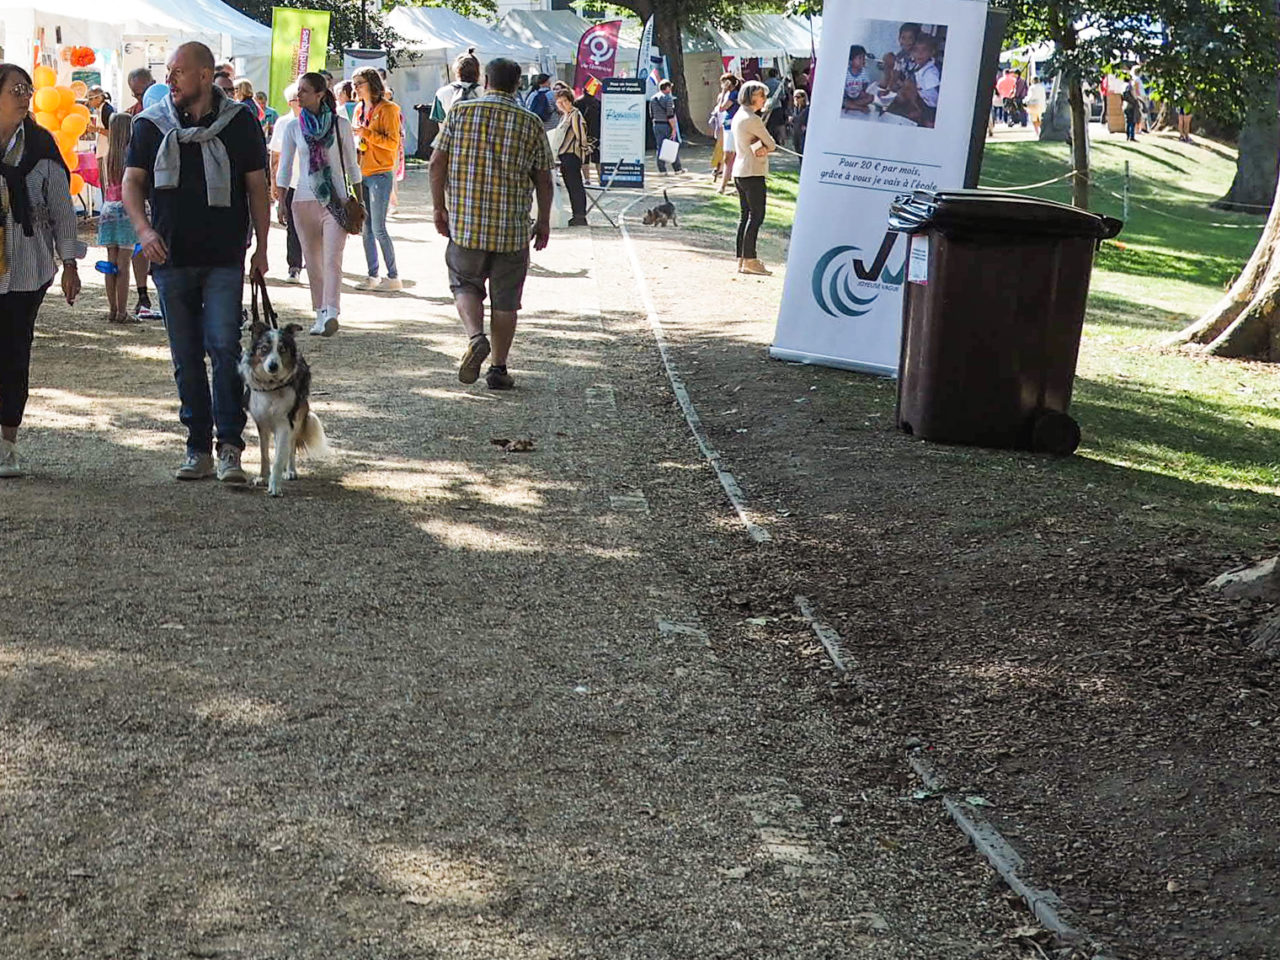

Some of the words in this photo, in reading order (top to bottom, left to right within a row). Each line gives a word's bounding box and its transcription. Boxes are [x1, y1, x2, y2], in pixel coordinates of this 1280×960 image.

[838, 157, 859, 168] Pour
[860, 160, 873, 170] 20
[874, 162, 882, 171] €
[880, 165, 898, 174] par
[820, 169, 843, 180] grâce
[844, 171, 851, 180] à
[852, 174, 871, 183] vous
[871, 176, 882, 186] je
[883, 178, 901, 187] vais
[902, 178, 908, 188] à
[856, 280, 881, 290] JOYEUSE
[881, 284, 900, 293] VAGUE
